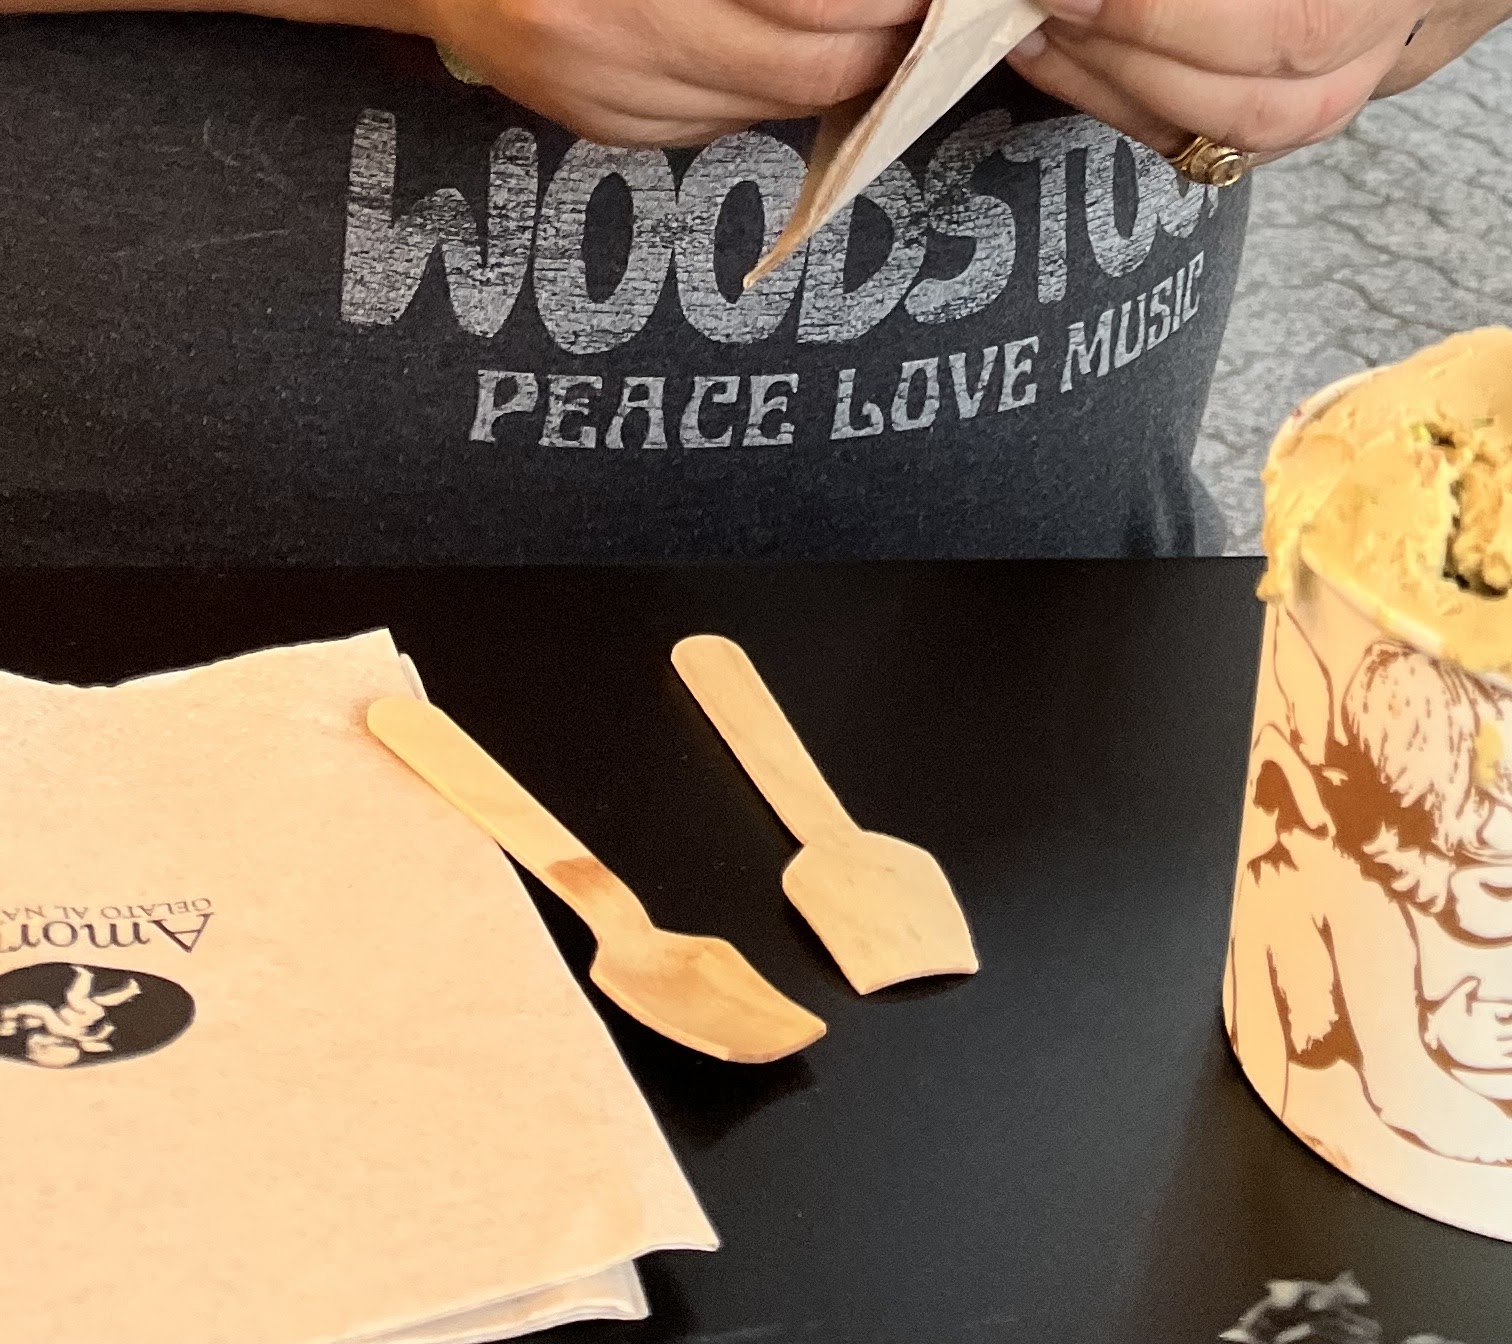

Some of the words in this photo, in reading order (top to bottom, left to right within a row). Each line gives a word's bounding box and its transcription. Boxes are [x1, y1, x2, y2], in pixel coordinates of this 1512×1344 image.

[341, 108, 1218, 355] WOODSTO
[469, 368, 799, 450] PEACE
[829, 336, 1039, 442] LOVE
[1060, 250, 1204, 394] MUSIC
[53, 904, 89, 920] AL
[99, 897, 212, 920] GELATO
[0, 912, 214, 953] Amor
